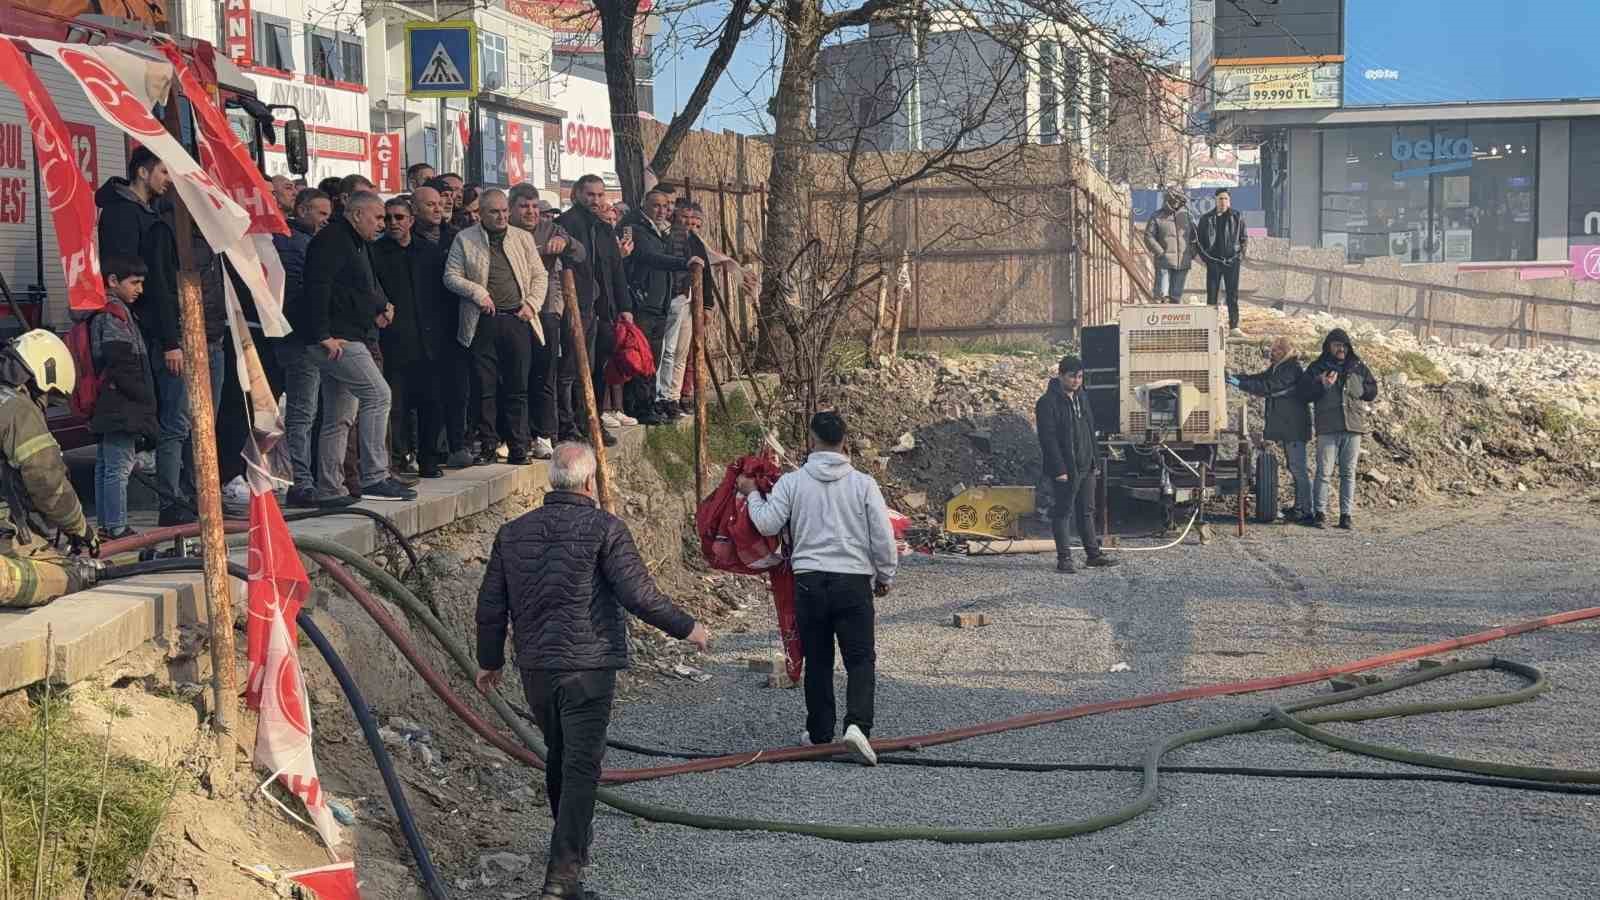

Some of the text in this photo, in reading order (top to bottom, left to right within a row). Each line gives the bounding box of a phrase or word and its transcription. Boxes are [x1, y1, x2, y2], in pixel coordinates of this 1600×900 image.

[1254, 88, 1311, 100] 99.990 TL
[1392, 134, 1473, 161] beko
[1161, 313, 1191, 321] POWER
